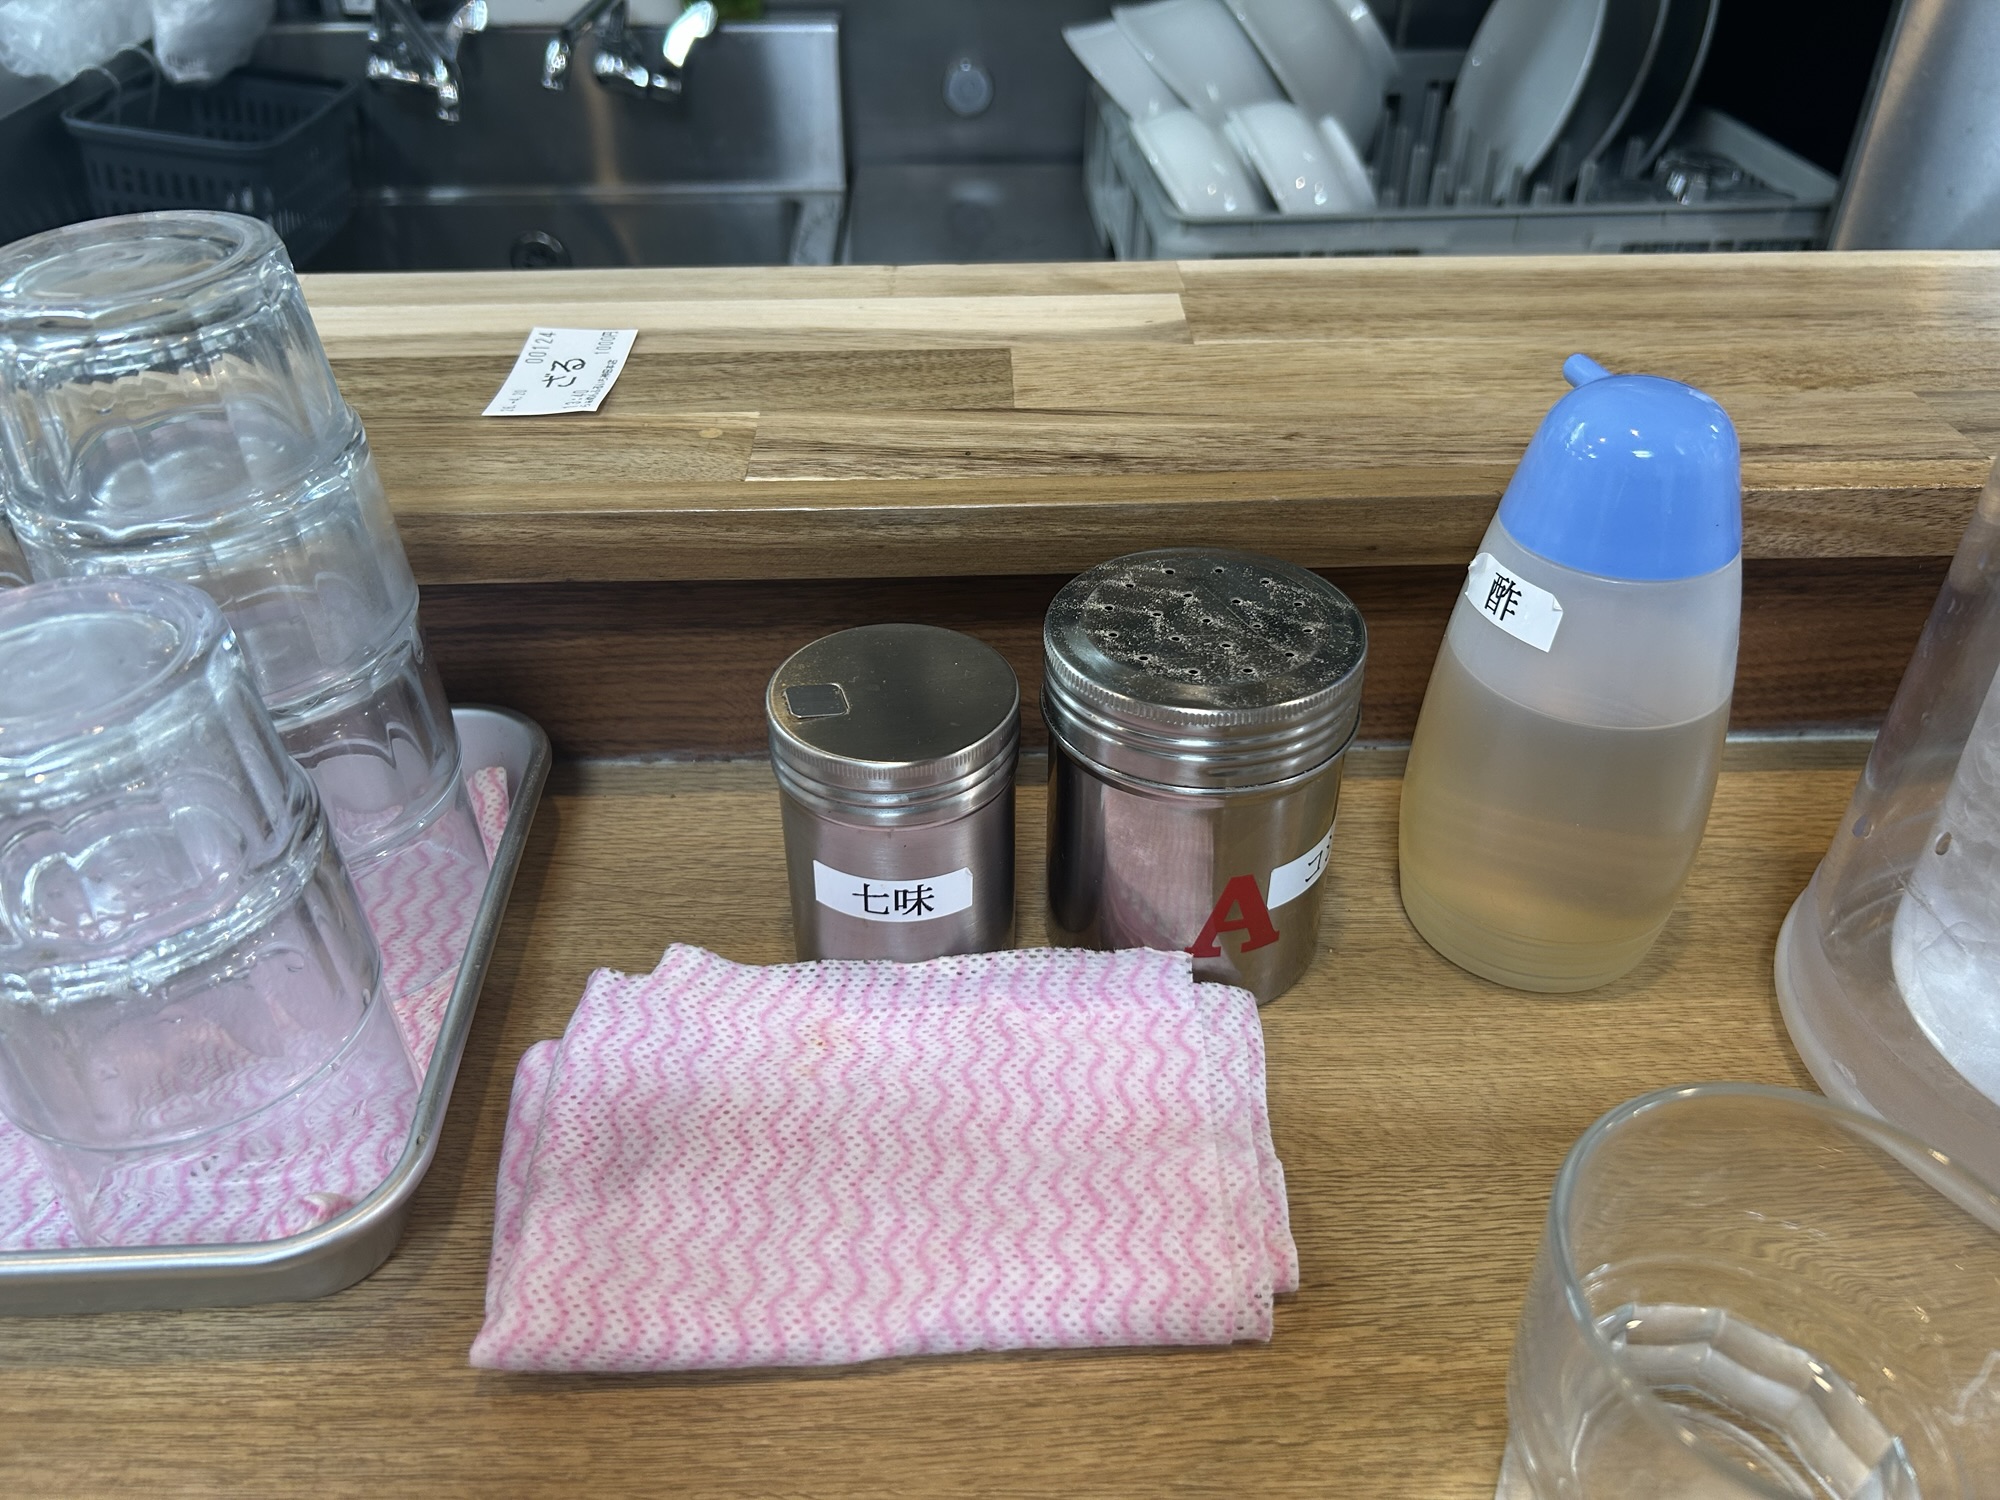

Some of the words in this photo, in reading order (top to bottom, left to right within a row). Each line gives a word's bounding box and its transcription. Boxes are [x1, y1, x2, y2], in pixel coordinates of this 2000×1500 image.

[525, 332, 556, 364] 00124
[542, 358, 586, 388] ざる
[562, 389, 589, 409] 13:40
[594, 331, 619, 354] 1000円
[1484, 572, 1522, 621] 酢
[852, 883, 935, 916] 七味
[1184, 874, 1280, 958] A
